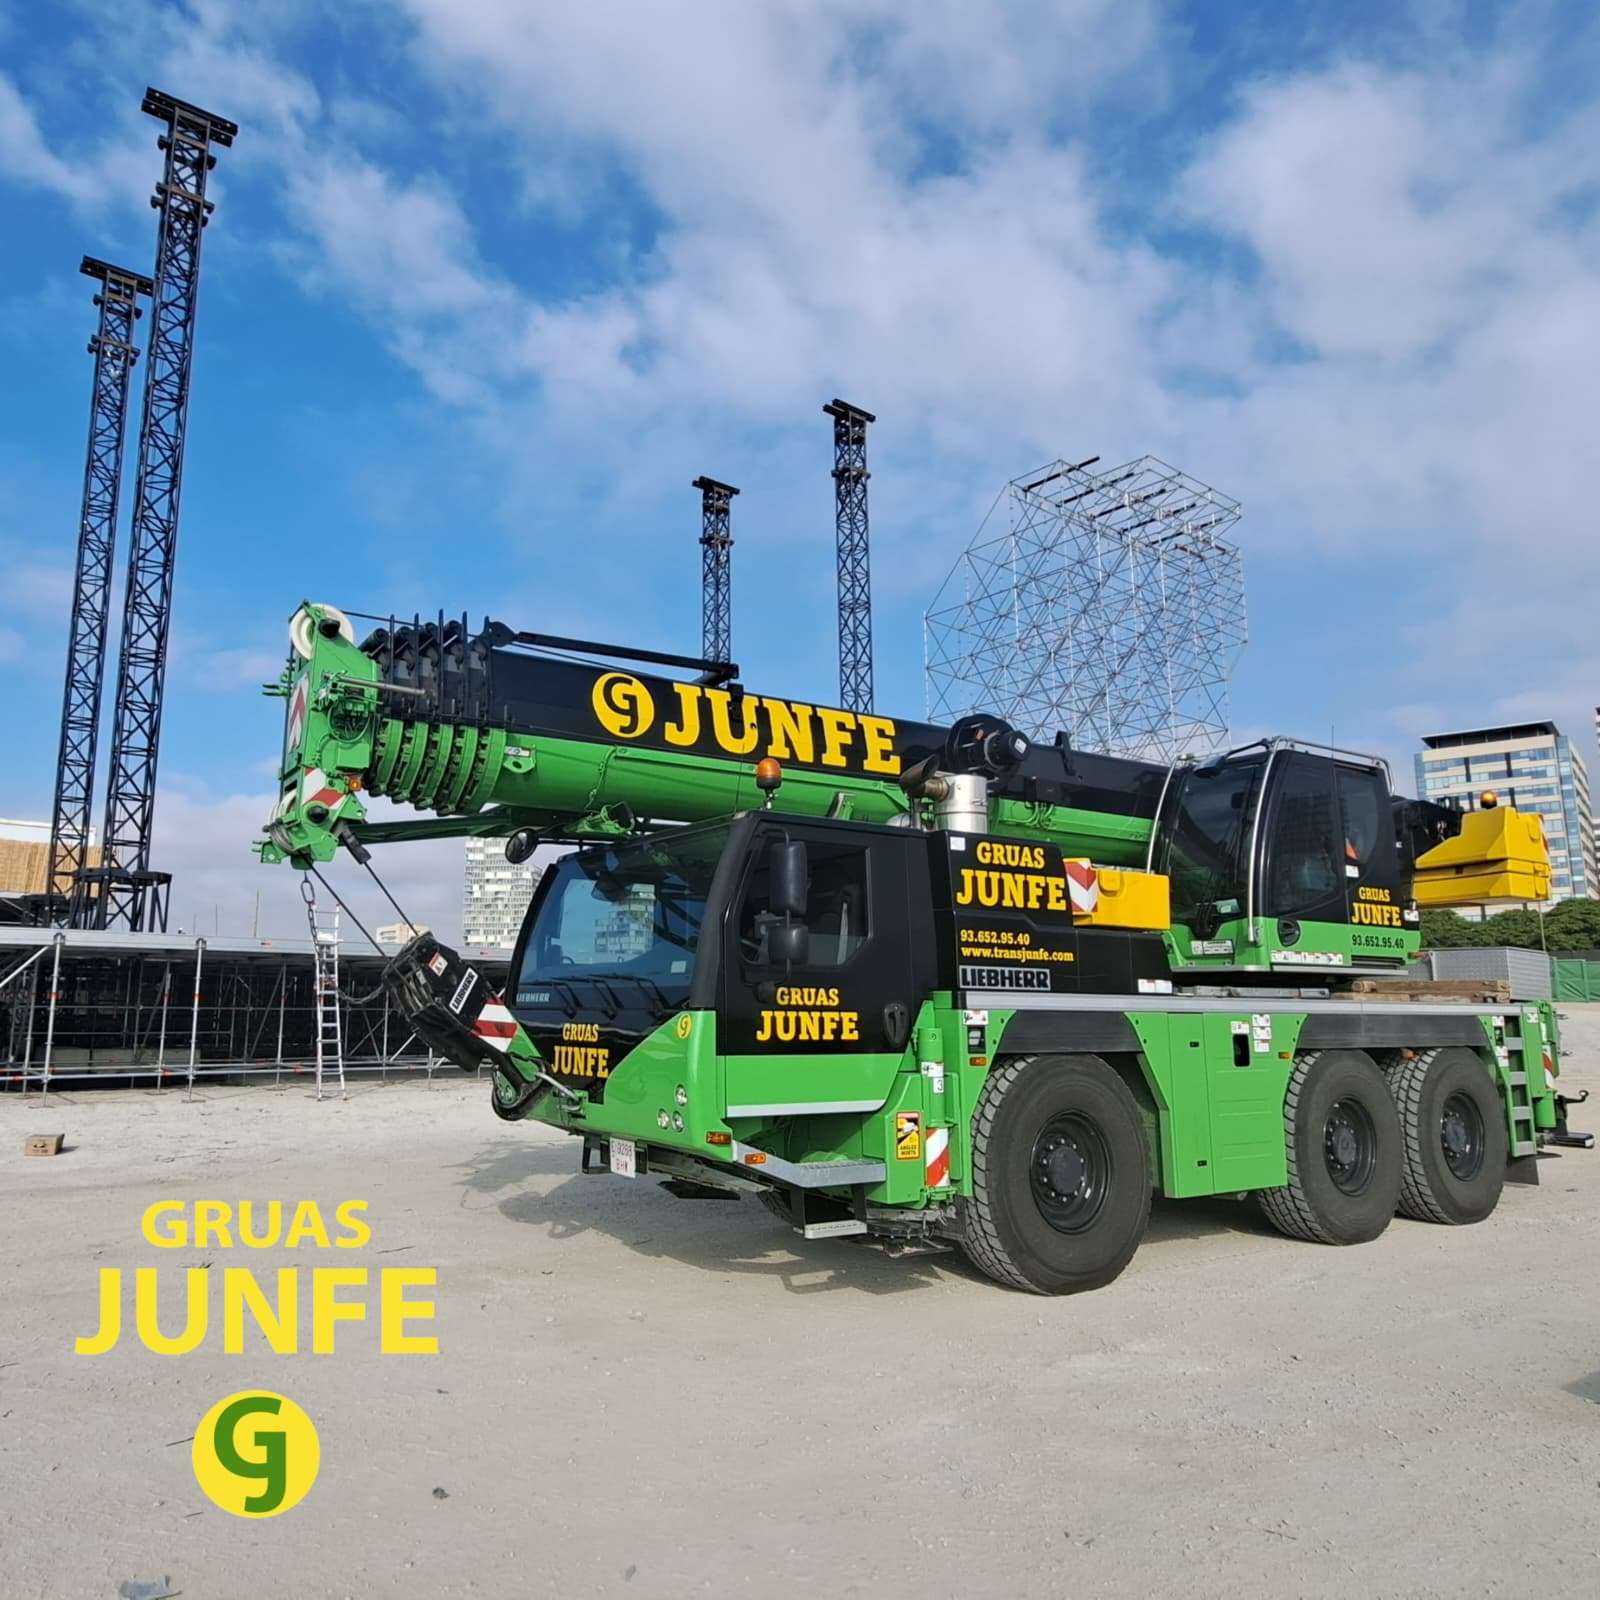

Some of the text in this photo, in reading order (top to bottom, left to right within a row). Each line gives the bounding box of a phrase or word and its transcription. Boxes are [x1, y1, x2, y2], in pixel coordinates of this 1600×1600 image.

[664, 682, 900, 775] JUNFE
[976, 841, 1045, 869] GRUAS
[956, 868, 1067, 911] JUNFE
[1358, 887, 1391, 902] GRUAS
[1351, 902, 1402, 927] JUNFE
[960, 929, 1030, 945] 93.652.95.40
[1352, 934, 1404, 949] 93.652.95.40
[961, 946, 1074, 963] www.transjunfe.com
[960, 967, 1050, 989] LIEBHERR
[776, 986, 840, 1007] GRUAS
[562, 1023, 599, 1042] GRUAS
[756, 1010, 859, 1042] JUNFE
[551, 1045, 609, 1078] JUNFE
